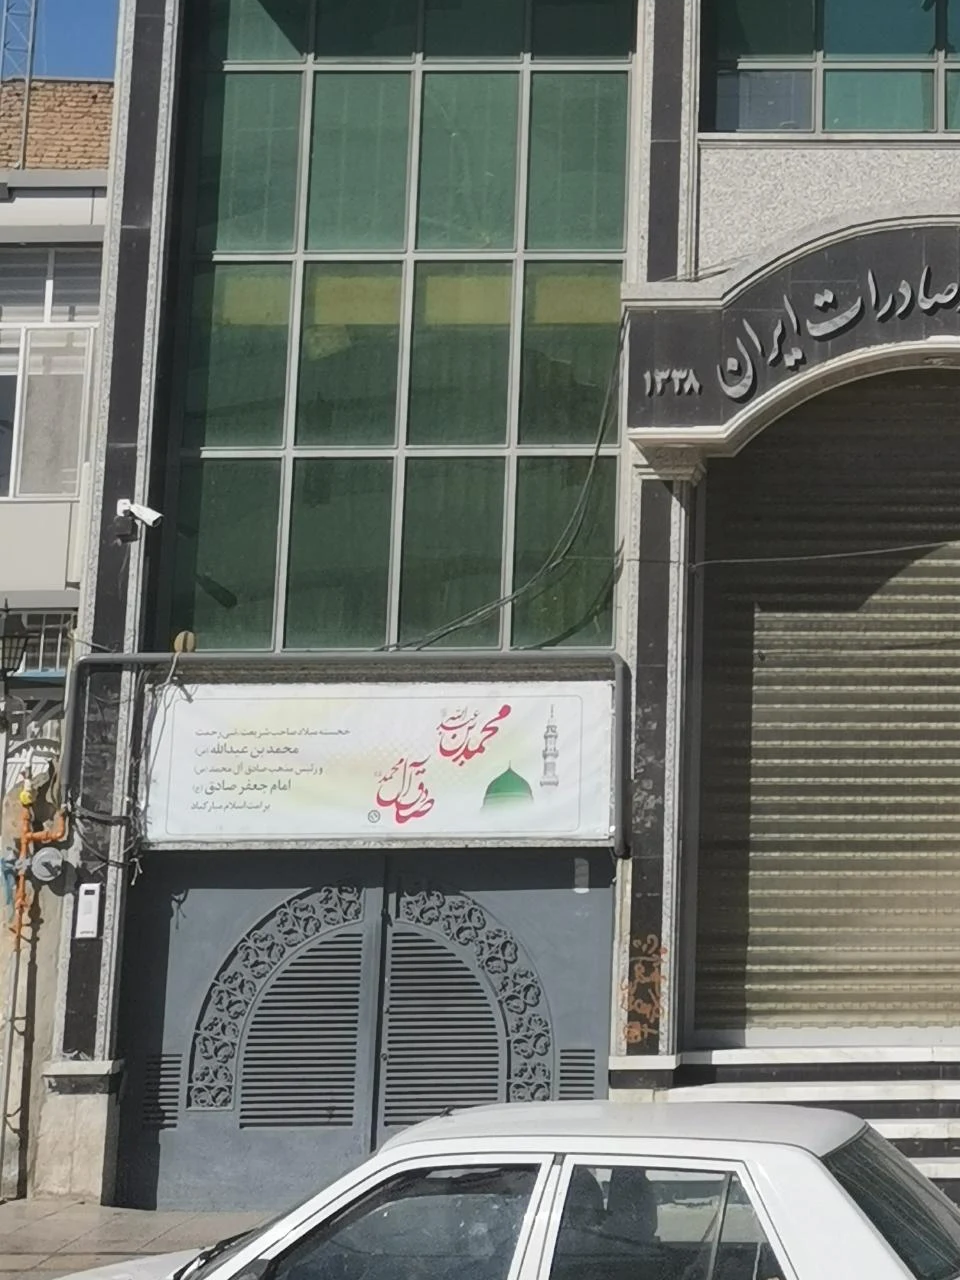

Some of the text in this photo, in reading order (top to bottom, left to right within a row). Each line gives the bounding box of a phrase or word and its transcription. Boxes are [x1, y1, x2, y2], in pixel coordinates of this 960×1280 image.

[805, 264, 960, 338] صادرات
[716, 293, 803, 399] ایران
[643, 368, 701, 397] ۱۳۳۸
[210, 742, 249, 757] عبدالله
[250, 745, 266, 758] بن
[266, 744, 300, 755] محمد
[204, 779, 237, 795] صادق
[238, 778, 268, 795] جعفر
[270, 778, 292, 794] امام
